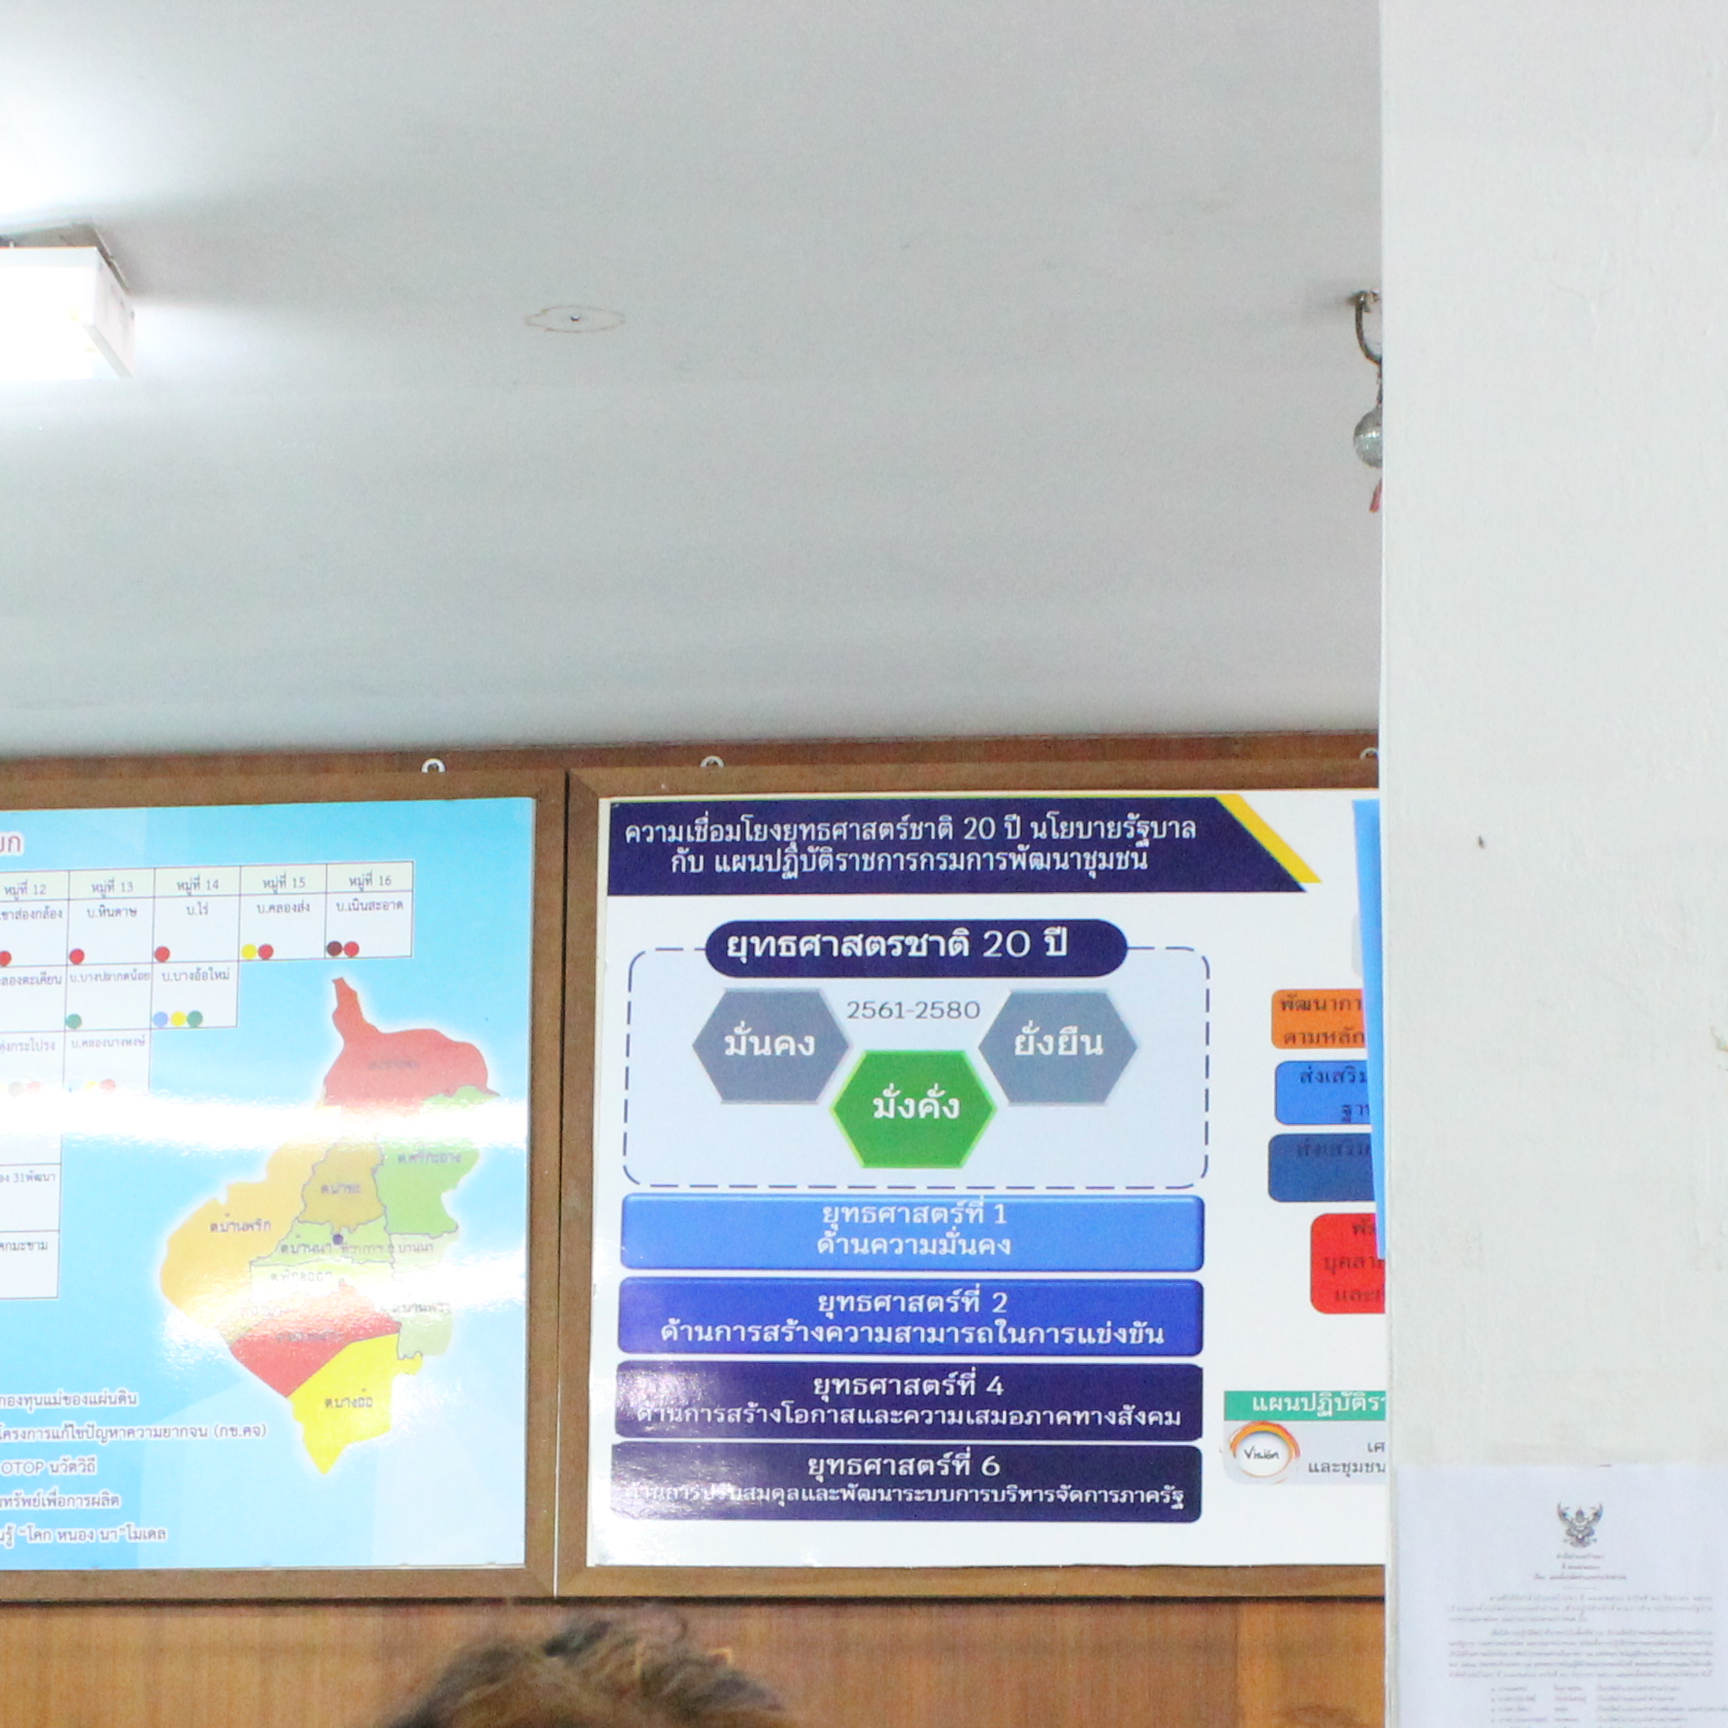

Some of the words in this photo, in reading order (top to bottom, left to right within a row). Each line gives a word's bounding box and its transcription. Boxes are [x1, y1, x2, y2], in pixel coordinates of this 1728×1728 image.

[625, 815, 954, 850] ความเชื่อมโยงยุทธศาสตร์ชาติ
[963, 817, 996, 841] 20
[1003, 813, 1021, 840] ปี
[1029, 812, 1197, 849] นโยบายรัฐบาล
[671, 847, 704, 873] กับ
[714, 841, 1150, 880] แผนปฏิบัติราชการกรมการพัฒนาชุมชน
[33, 883, 47, 896] 12
[120, 881, 134, 893] 13
[206, 879, 220, 891] 14
[292, 876, 306, 889] 15
[379, 875, 392, 887] 16
[983, 929, 1031, 958] 20
[1044, 923, 1069, 960] ปี
[847, 1000, 981, 1020] 2561-2580
[724, 1023, 815, 1057] มั่นคง
[1014, 1022, 1104, 1060] ยั่งยืน
[872, 1085, 960, 1124] มั่งคั่ง
[820, 1195, 986, 1230] ยุทธศาสตร์ที่
[994, 1203, 1007, 1225] 1
[816, 1227, 1012, 1256] ด้านความมั่นคง
[818, 1285, 981, 1320] ยุทธศาสตร์ที่
[992, 1291, 1008, 1313] 2
[659, 1317, 1165, 1348] ด้านการสร้างความสามารถในการแข่งขัน
[813, 1370, 977, 1402] ยุทธศาสตร์ที่
[985, 1375, 1004, 1396] 4
[0, 1459, 45, 1478] OTOP
[807, 1449, 971, 1484] ยุทธศาสตร์ที่
[981, 1455, 1001, 1476] 6
[55, 1525, 96, 1544] หนอง
